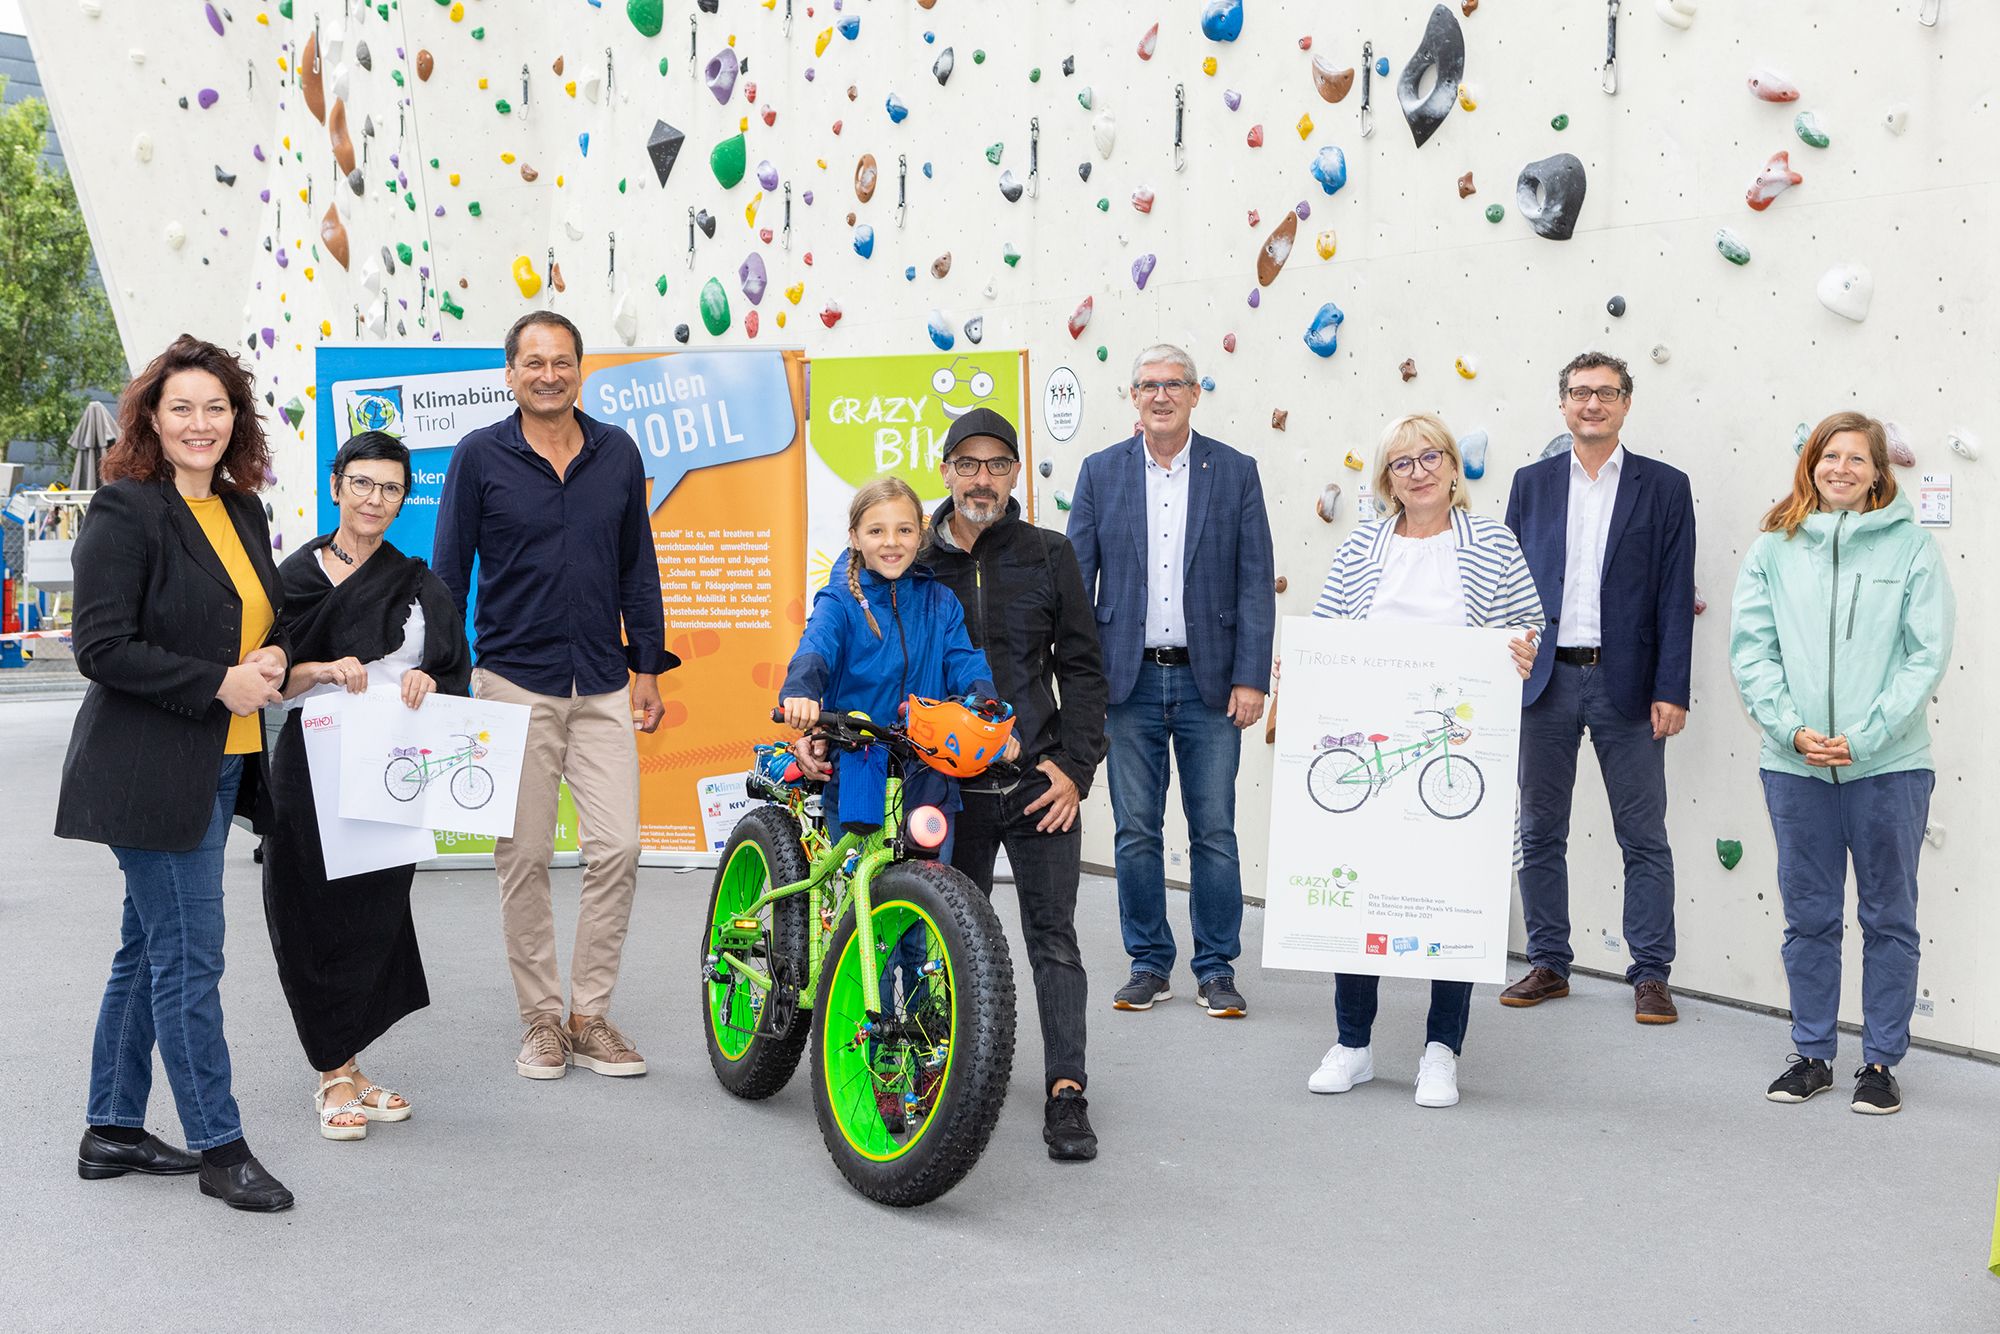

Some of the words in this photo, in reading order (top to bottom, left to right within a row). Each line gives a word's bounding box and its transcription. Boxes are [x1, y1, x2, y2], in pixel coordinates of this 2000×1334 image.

[600, 372, 706, 415] Schulen
[828, 394, 928, 424] CRAZY
[414, 412, 455, 432] Tirol
[874, 426, 949, 474] BIK
[412, 468, 446, 484] nken
[723, 529, 754, 538] kreativen
[757, 529, 770, 538] und
[699, 555, 725, 564] Kindern
[728, 556, 740, 564] und
[758, 568, 771, 576] sich
[670, 608, 708, 616] bestehende
[710, 608, 759, 617] Schulangebote
[671, 620, 731, 629] Unterrichtsmodule
[1289, 875, 1330, 888] CRAZY
[1308, 889, 1355, 907] BIKE
